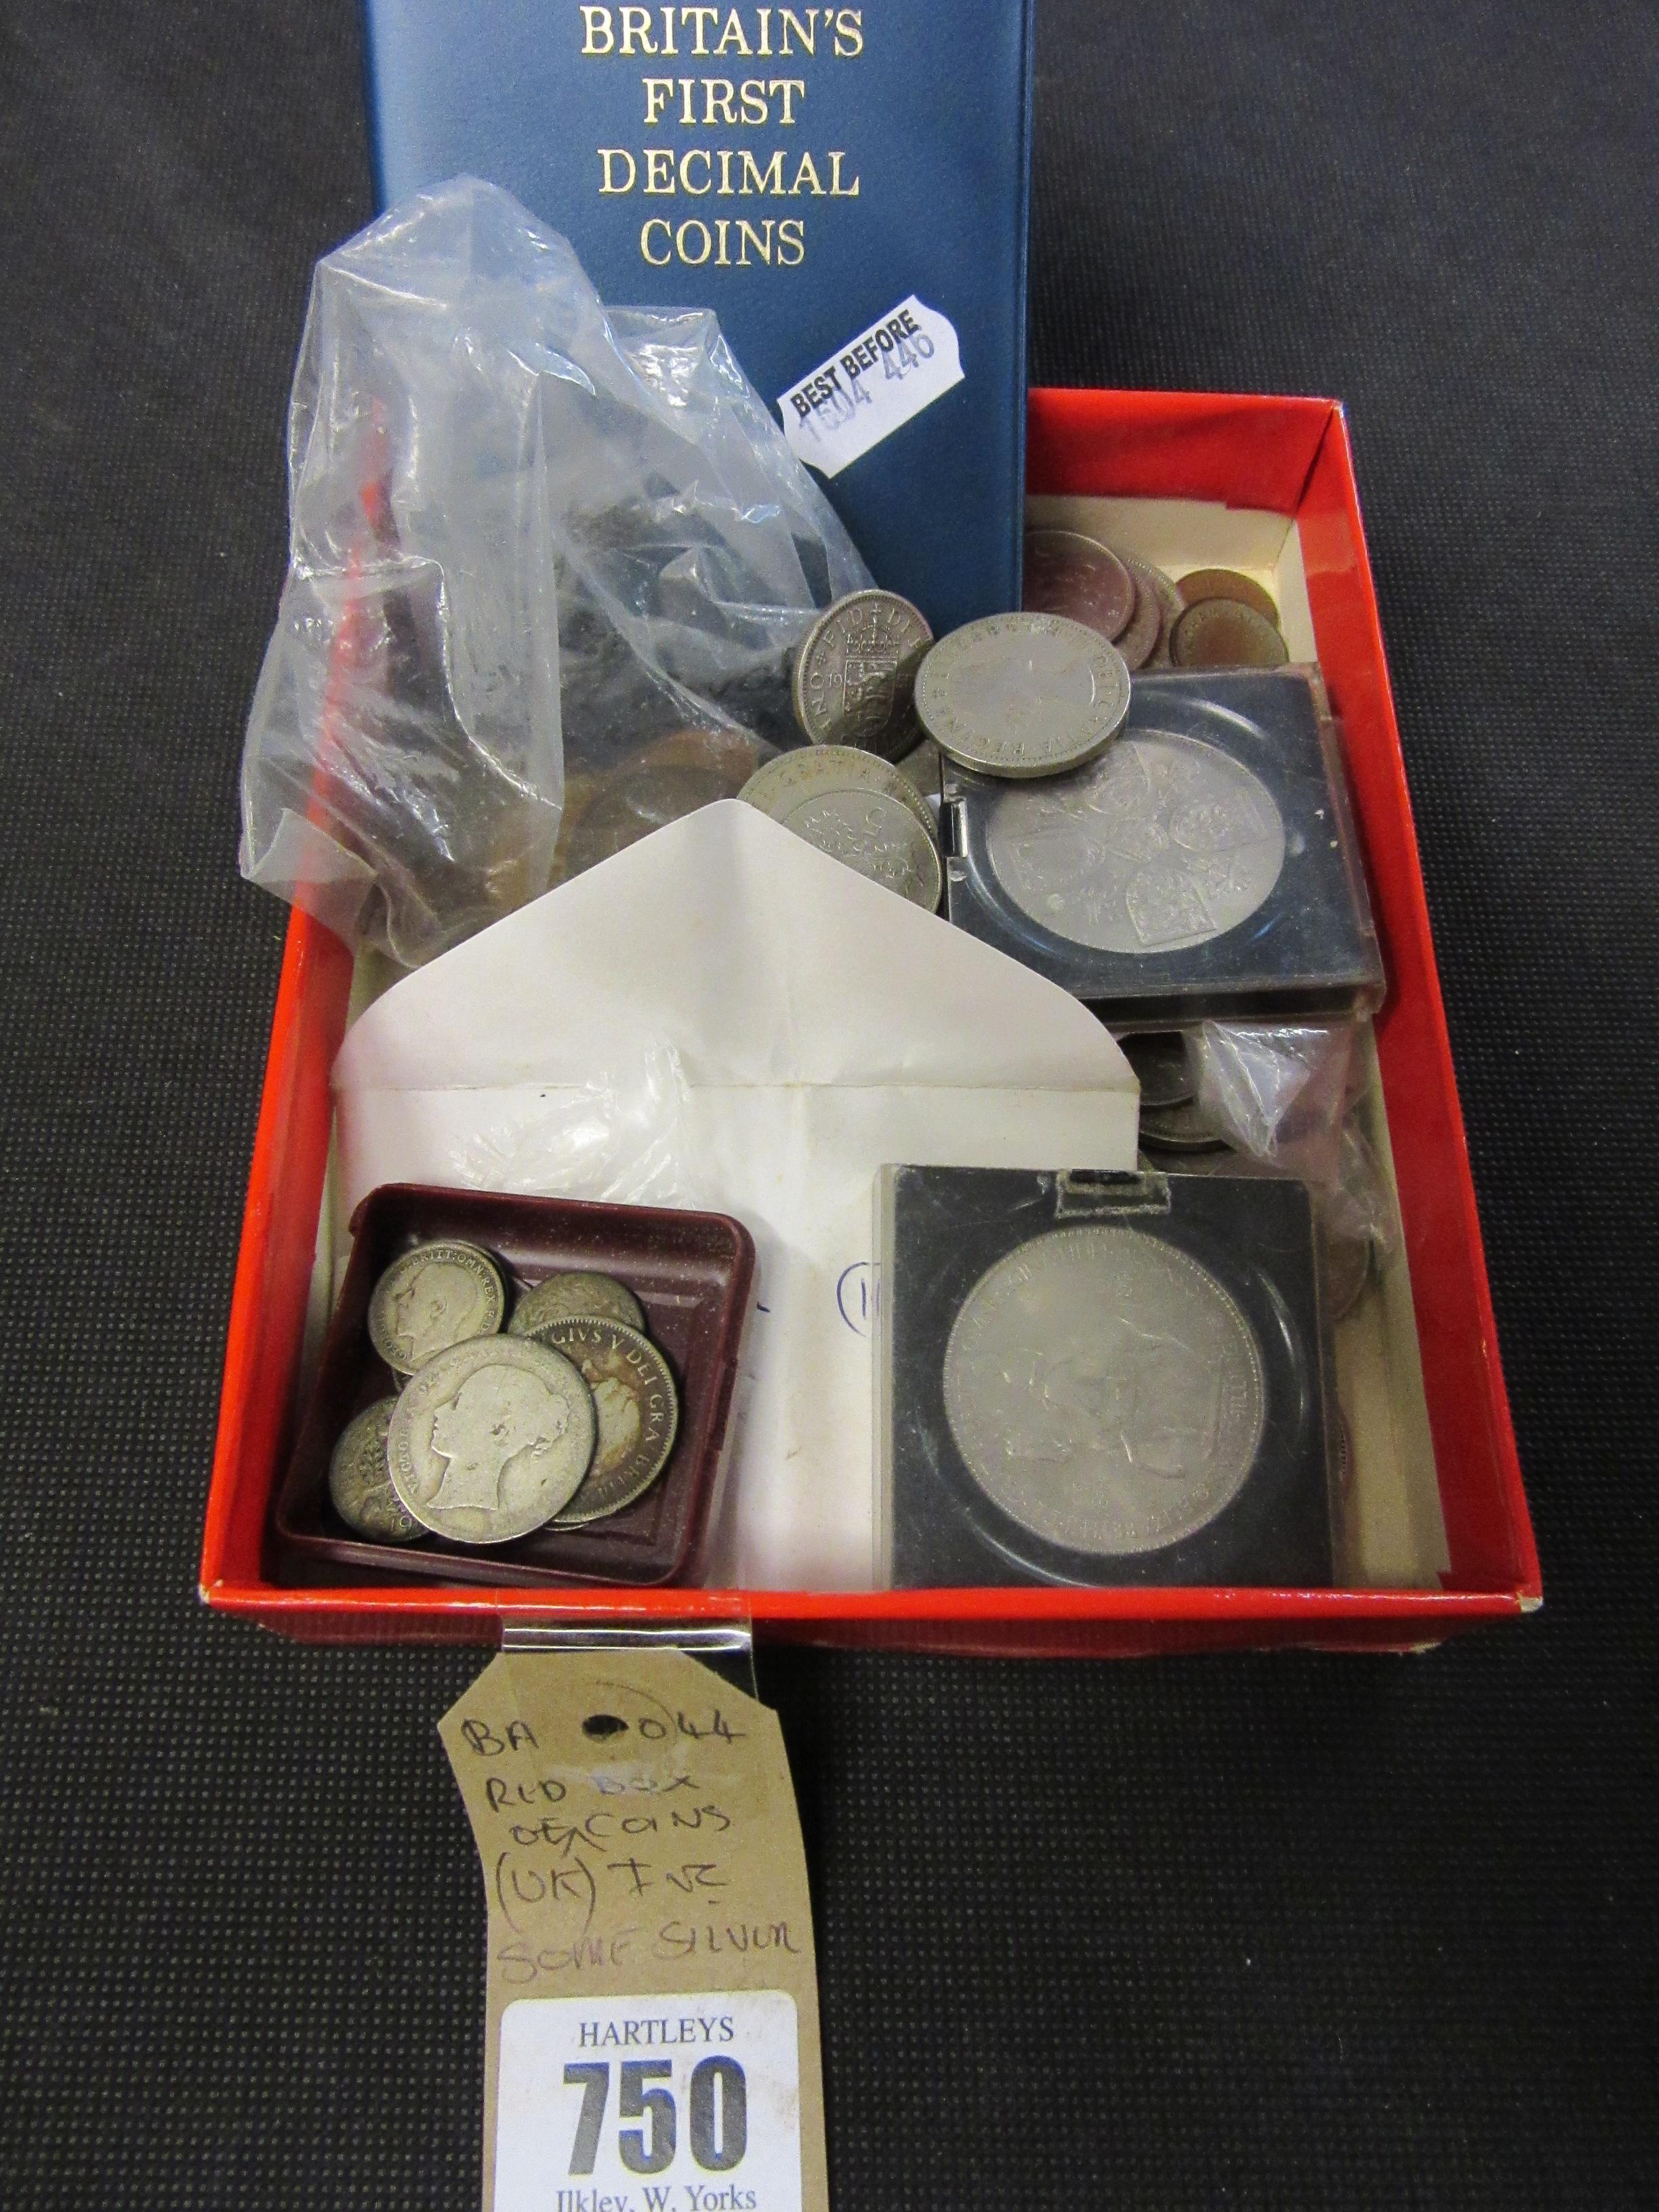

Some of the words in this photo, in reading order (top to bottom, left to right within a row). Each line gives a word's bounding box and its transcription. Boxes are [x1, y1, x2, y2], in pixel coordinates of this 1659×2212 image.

[580, 5, 865, 57] BRITAIN'S
[642, 77, 806, 125] FIRST
[596, 148, 861, 196] DECIMAL
[640, 218, 806, 266] COINS
[790, 365, 842, 419] BEST
[840, 309, 921, 381] BEFORE
[551, 1328, 602, 1345] GIVS
[461, 1718, 539, 1756] BA
[639, 1709, 746, 1745] 044
[585, 1804, 731, 1839] COINS
[578, 2015, 735, 2047] HARTLEYS
[563, 2055, 747, 2176] 750
[684, 2183, 757, 2211] Yorks
